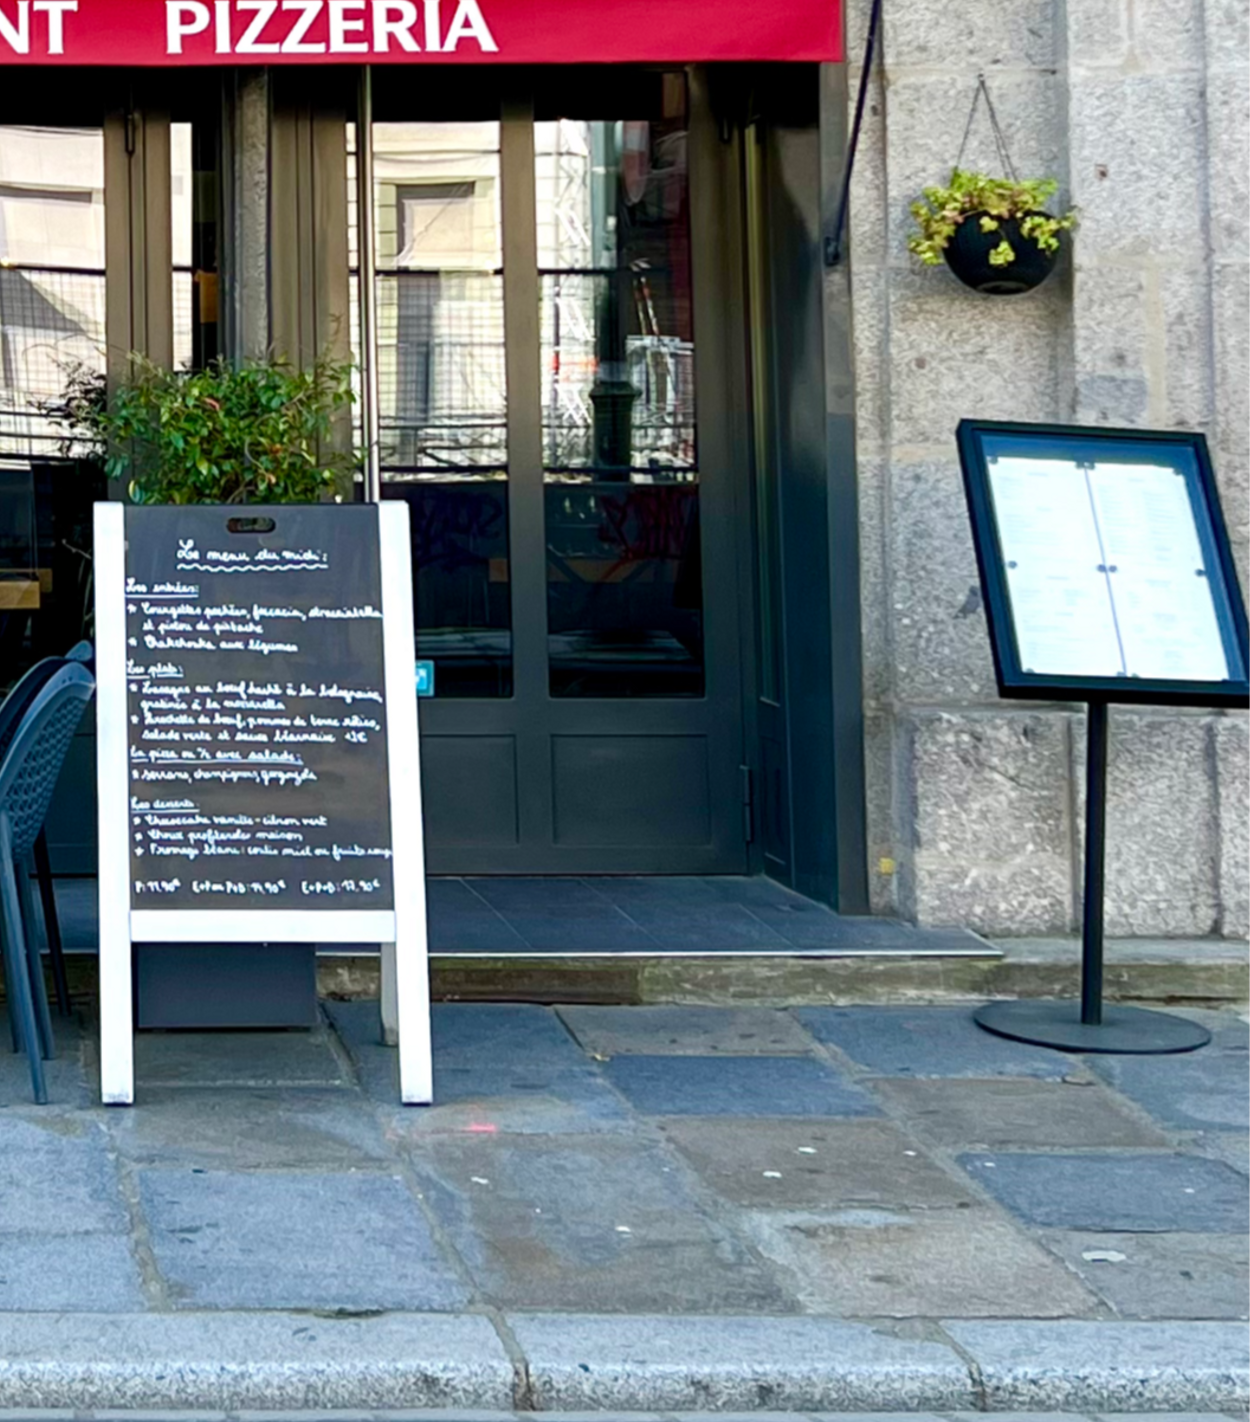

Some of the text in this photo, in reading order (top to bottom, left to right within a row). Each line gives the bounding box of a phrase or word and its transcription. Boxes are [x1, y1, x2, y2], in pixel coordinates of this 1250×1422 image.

[177, 538, 199, 560] Le
[206, 550, 250, 562] menu
[254, 548, 280, 561] du
[126, 577, 148, 593] Les
[142, 619, 155, 631] et
[196, 621, 210, 631] de
[219, 641, 245, 650] aux
[247, 639, 298, 655] légumes
[127, 660, 145, 674] Les
[195, 685, 213, 693] au
[285, 682, 297, 696] à
[299, 683, 316, 697] la
[191, 699, 202, 711] à
[205, 697, 220, 709] la
[197, 714, 211, 724] de
[292, 715, 307, 727] de
[310, 714, 340, 727] terre
[182, 730, 213, 741] verte
[216, 730, 231, 741] et
[130, 745, 146, 758] La
[148, 748, 179, 762] pizza
[215, 750, 242, 760] avec
[131, 796, 151, 810] Les
[262, 814, 300, 826] citron
[301, 815, 328, 826] vert
[255, 830, 303, 842] maison
[281, 846, 313, 857] miel
[314, 849, 330, 857] ou
[332, 844, 365, 861] fruits
